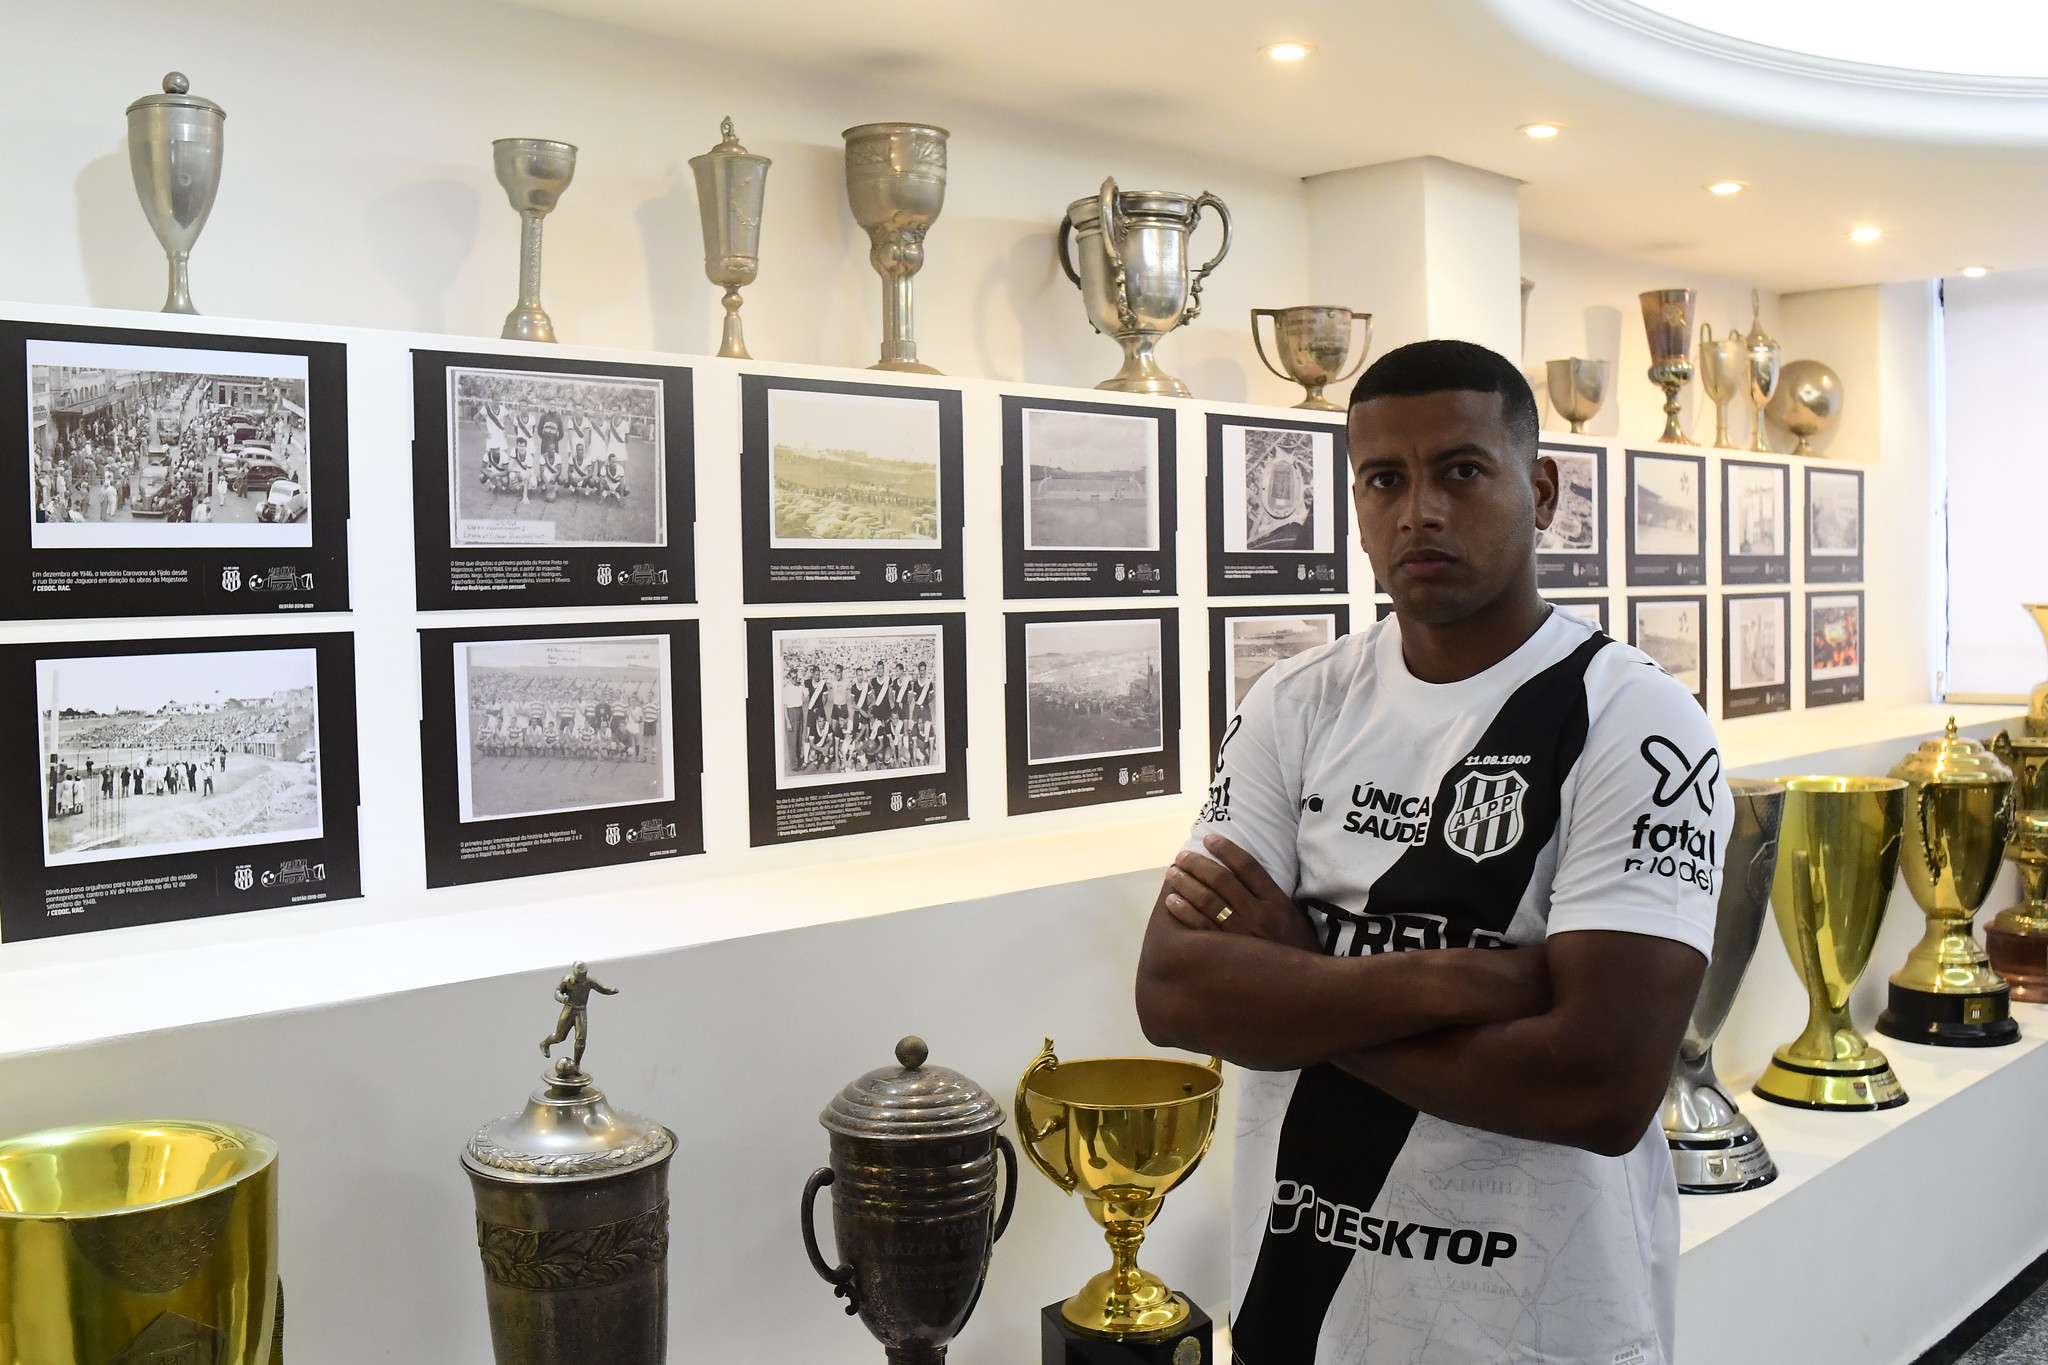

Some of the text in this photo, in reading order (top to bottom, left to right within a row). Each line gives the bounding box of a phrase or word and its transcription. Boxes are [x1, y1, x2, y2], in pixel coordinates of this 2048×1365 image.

[1465, 755, 1531, 766] 11.08.1900
[1352, 781, 1430, 818] ÚNICA
[1343, 816, 1427, 843] SAÚDE
[1632, 813, 1715, 866] fatal
[1316, 1199, 1518, 1268] DESKTOP
